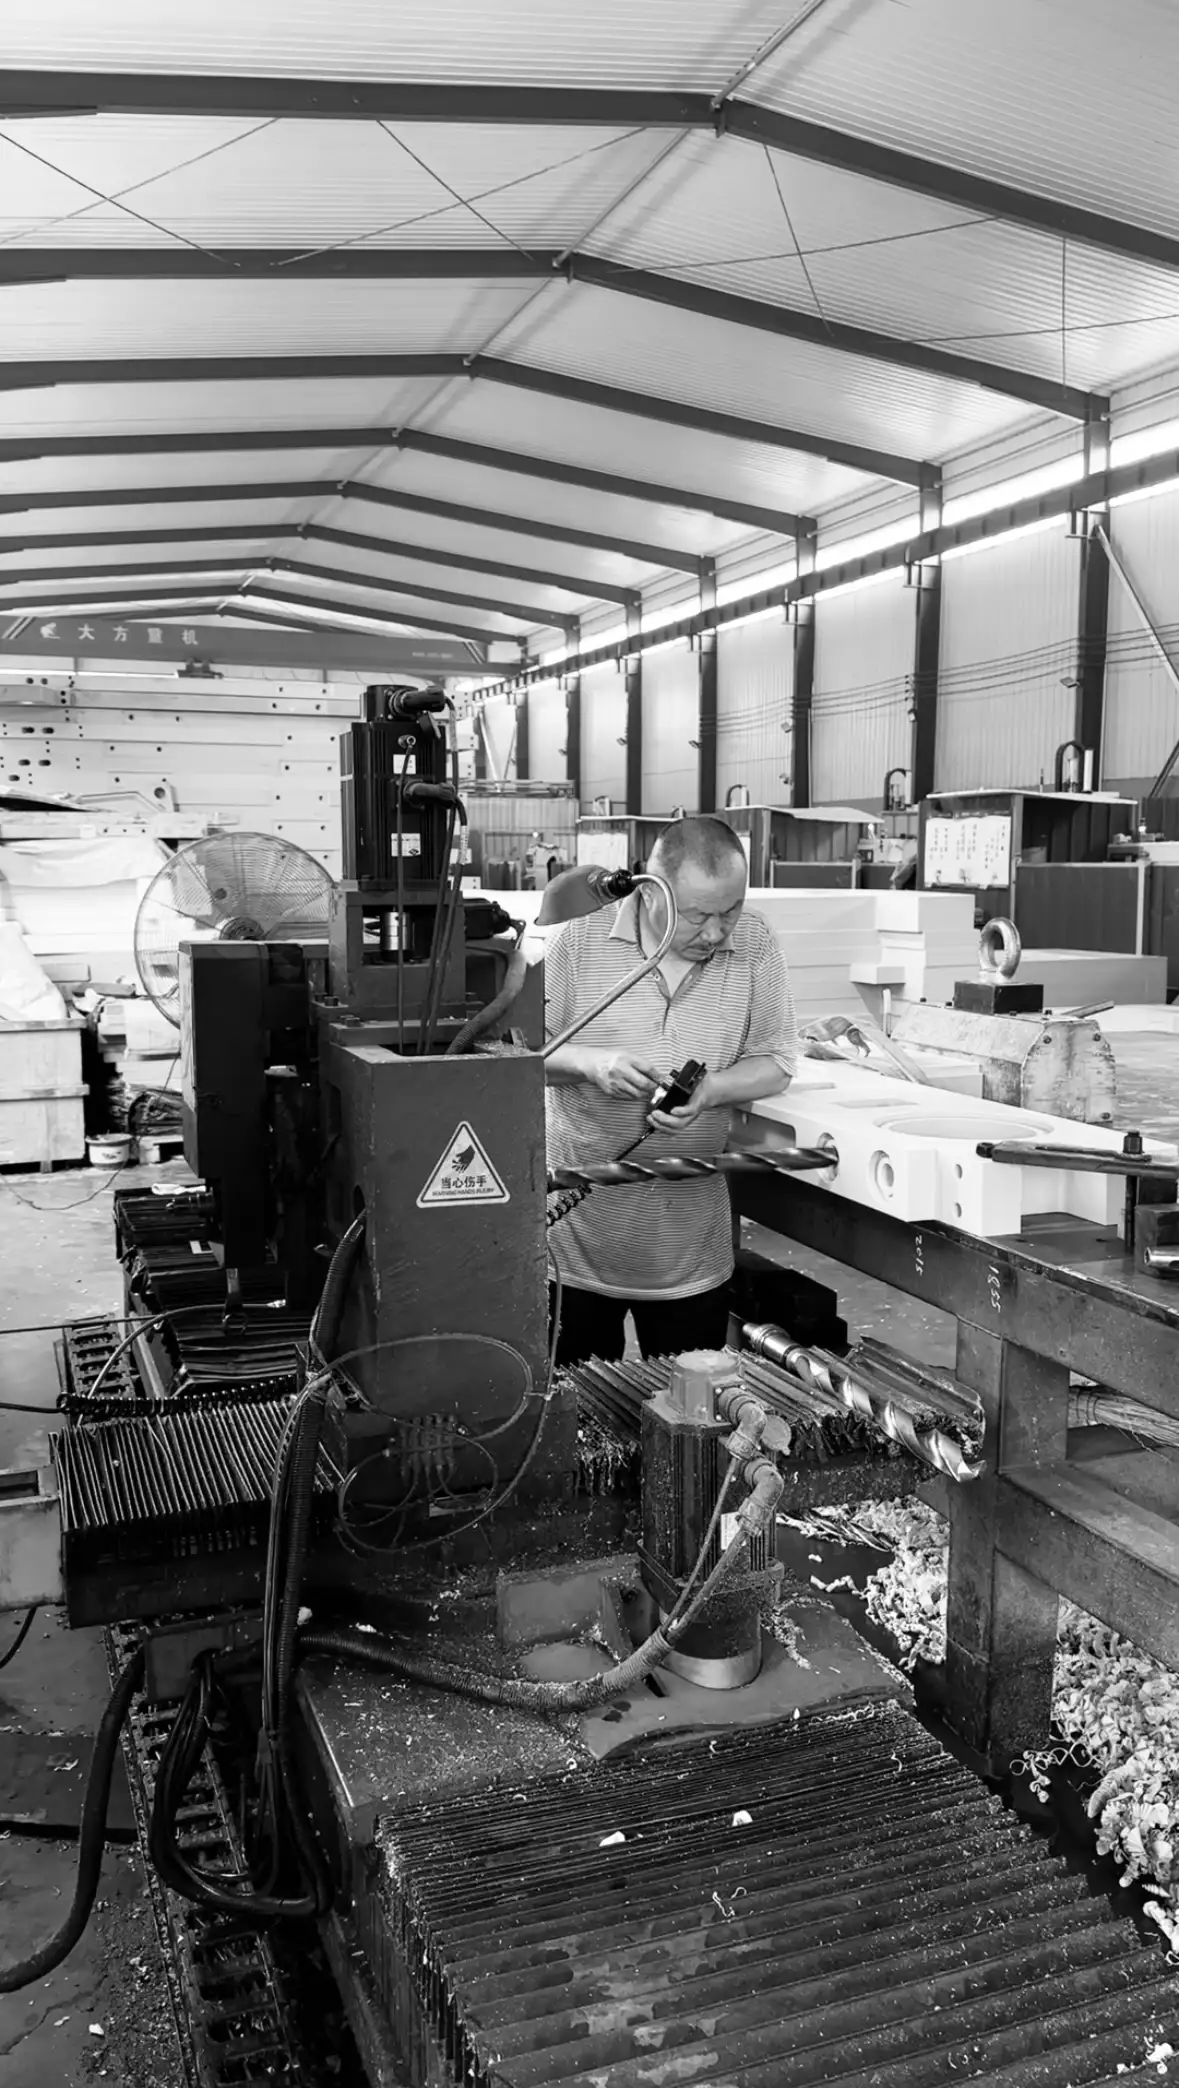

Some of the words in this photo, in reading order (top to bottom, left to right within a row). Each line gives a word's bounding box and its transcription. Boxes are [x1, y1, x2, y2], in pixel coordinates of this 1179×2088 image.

[441, 1175, 487, 1189] 当心伤手
[915, 1234, 924, 1276] 2015
[987, 1264, 1001, 1313] 1855
